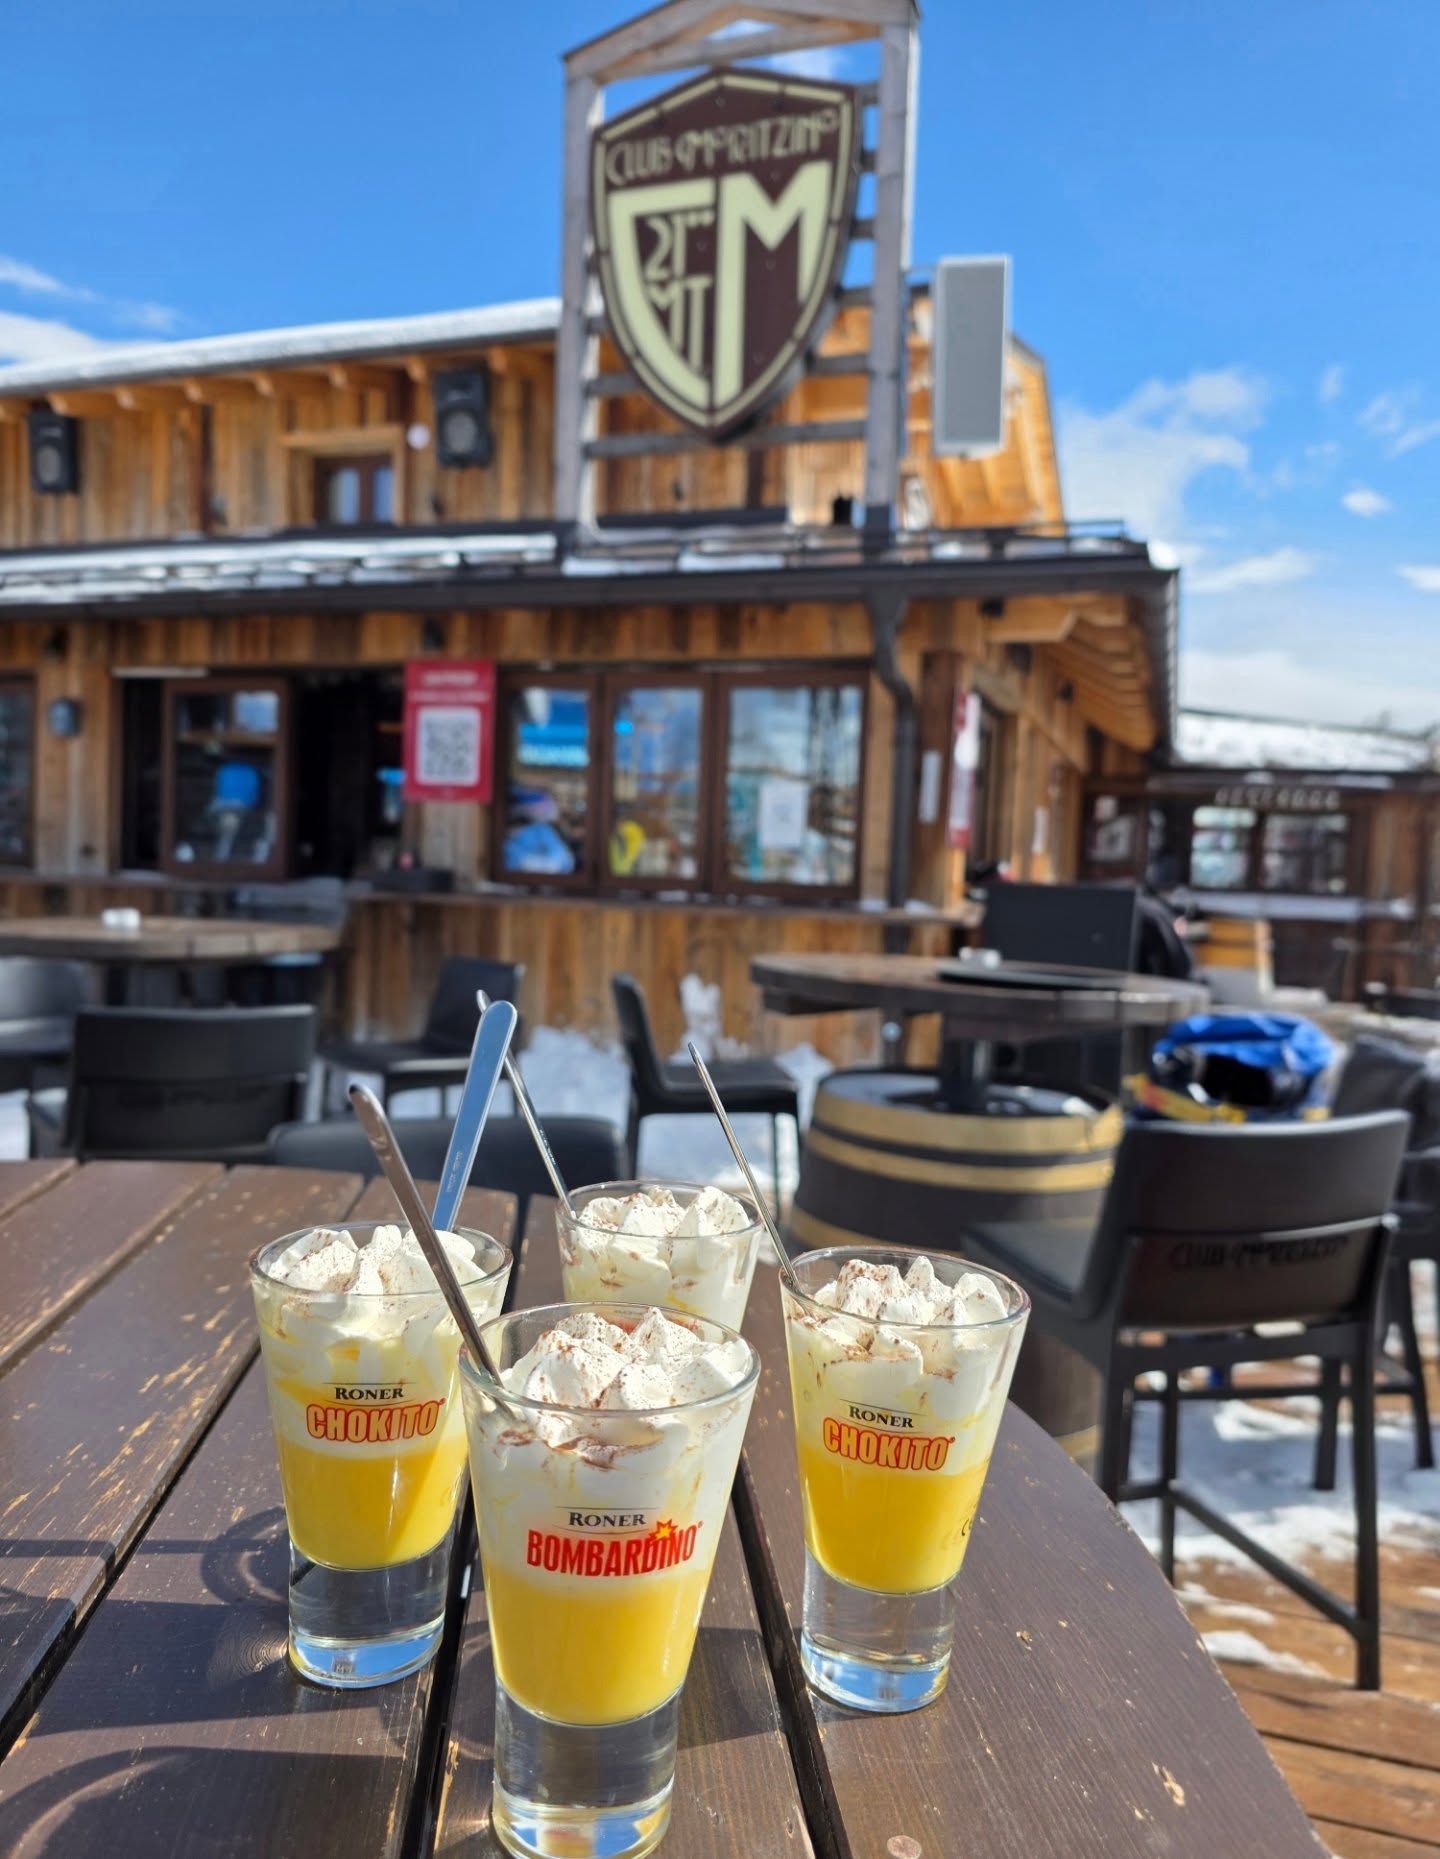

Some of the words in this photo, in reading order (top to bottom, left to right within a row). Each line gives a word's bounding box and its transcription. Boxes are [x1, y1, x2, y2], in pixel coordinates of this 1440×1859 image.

[606, 136, 674, 186] CLUB
[334, 1386, 405, 1401] RONER
[306, 1400, 442, 1443] CHOKITO
[848, 1404, 915, 1429] RONER
[822, 1417, 951, 1471] CHOKITO
[568, 1511, 647, 1528] RONER
[526, 1526, 699, 1578] BOMBARDINO
